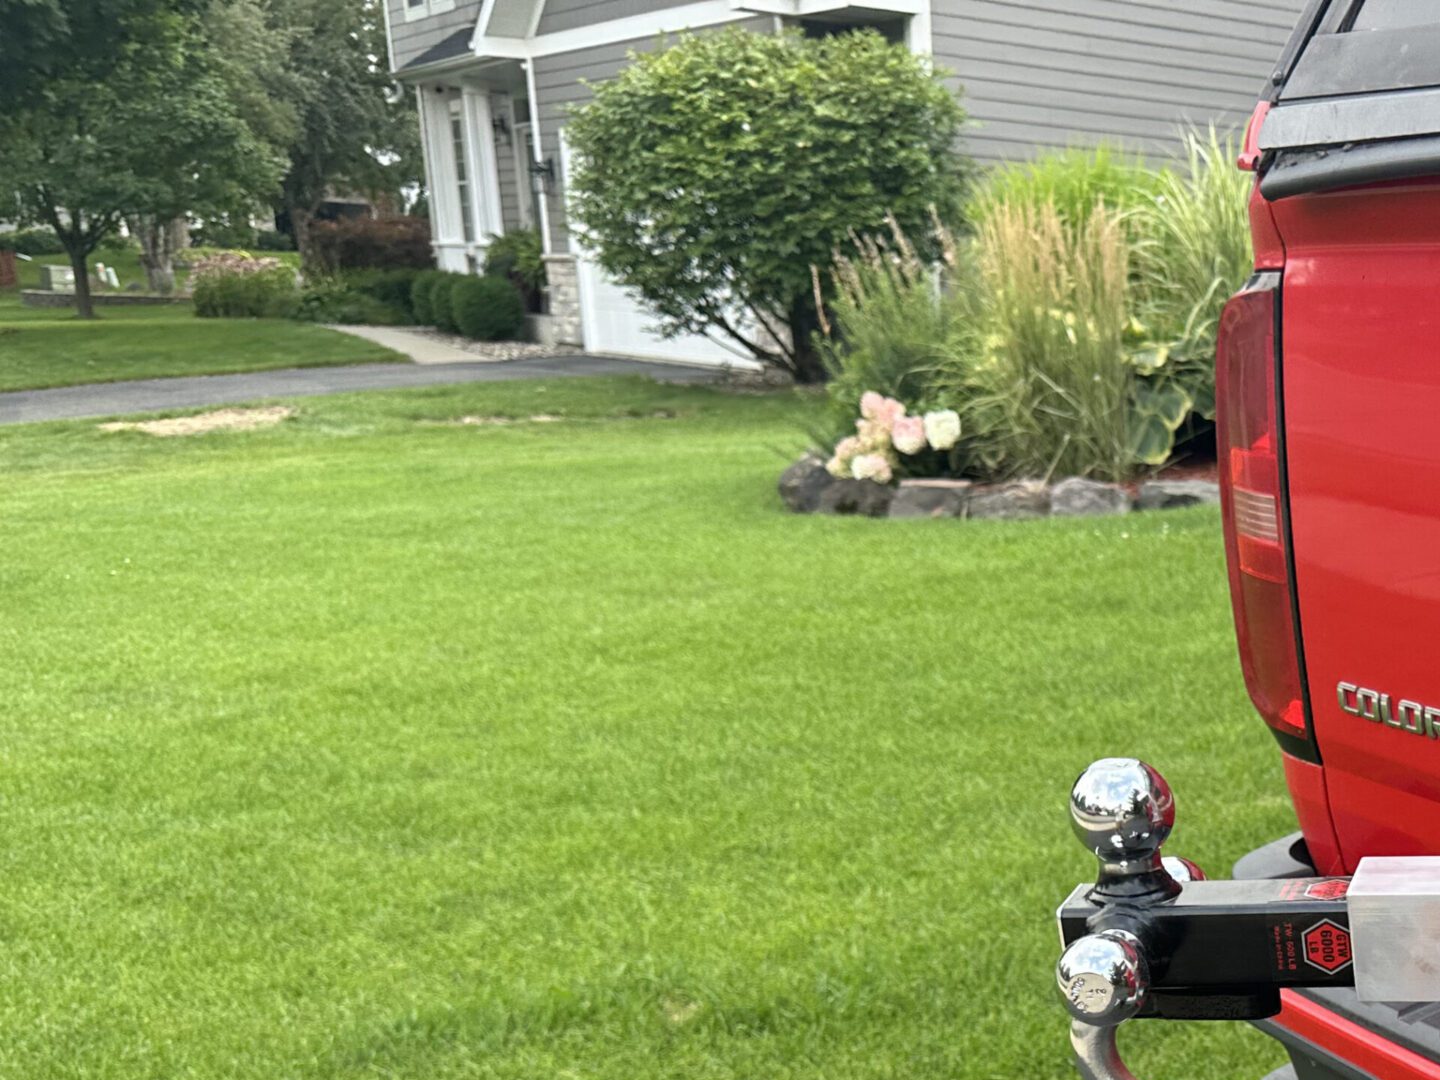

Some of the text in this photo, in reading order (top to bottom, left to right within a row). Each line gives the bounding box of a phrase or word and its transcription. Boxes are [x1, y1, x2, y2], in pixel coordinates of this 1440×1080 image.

[1309, 941, 1319, 953] LB
[1320, 930, 1335, 962] 6000
[1336, 934, 1348, 957] GTW
